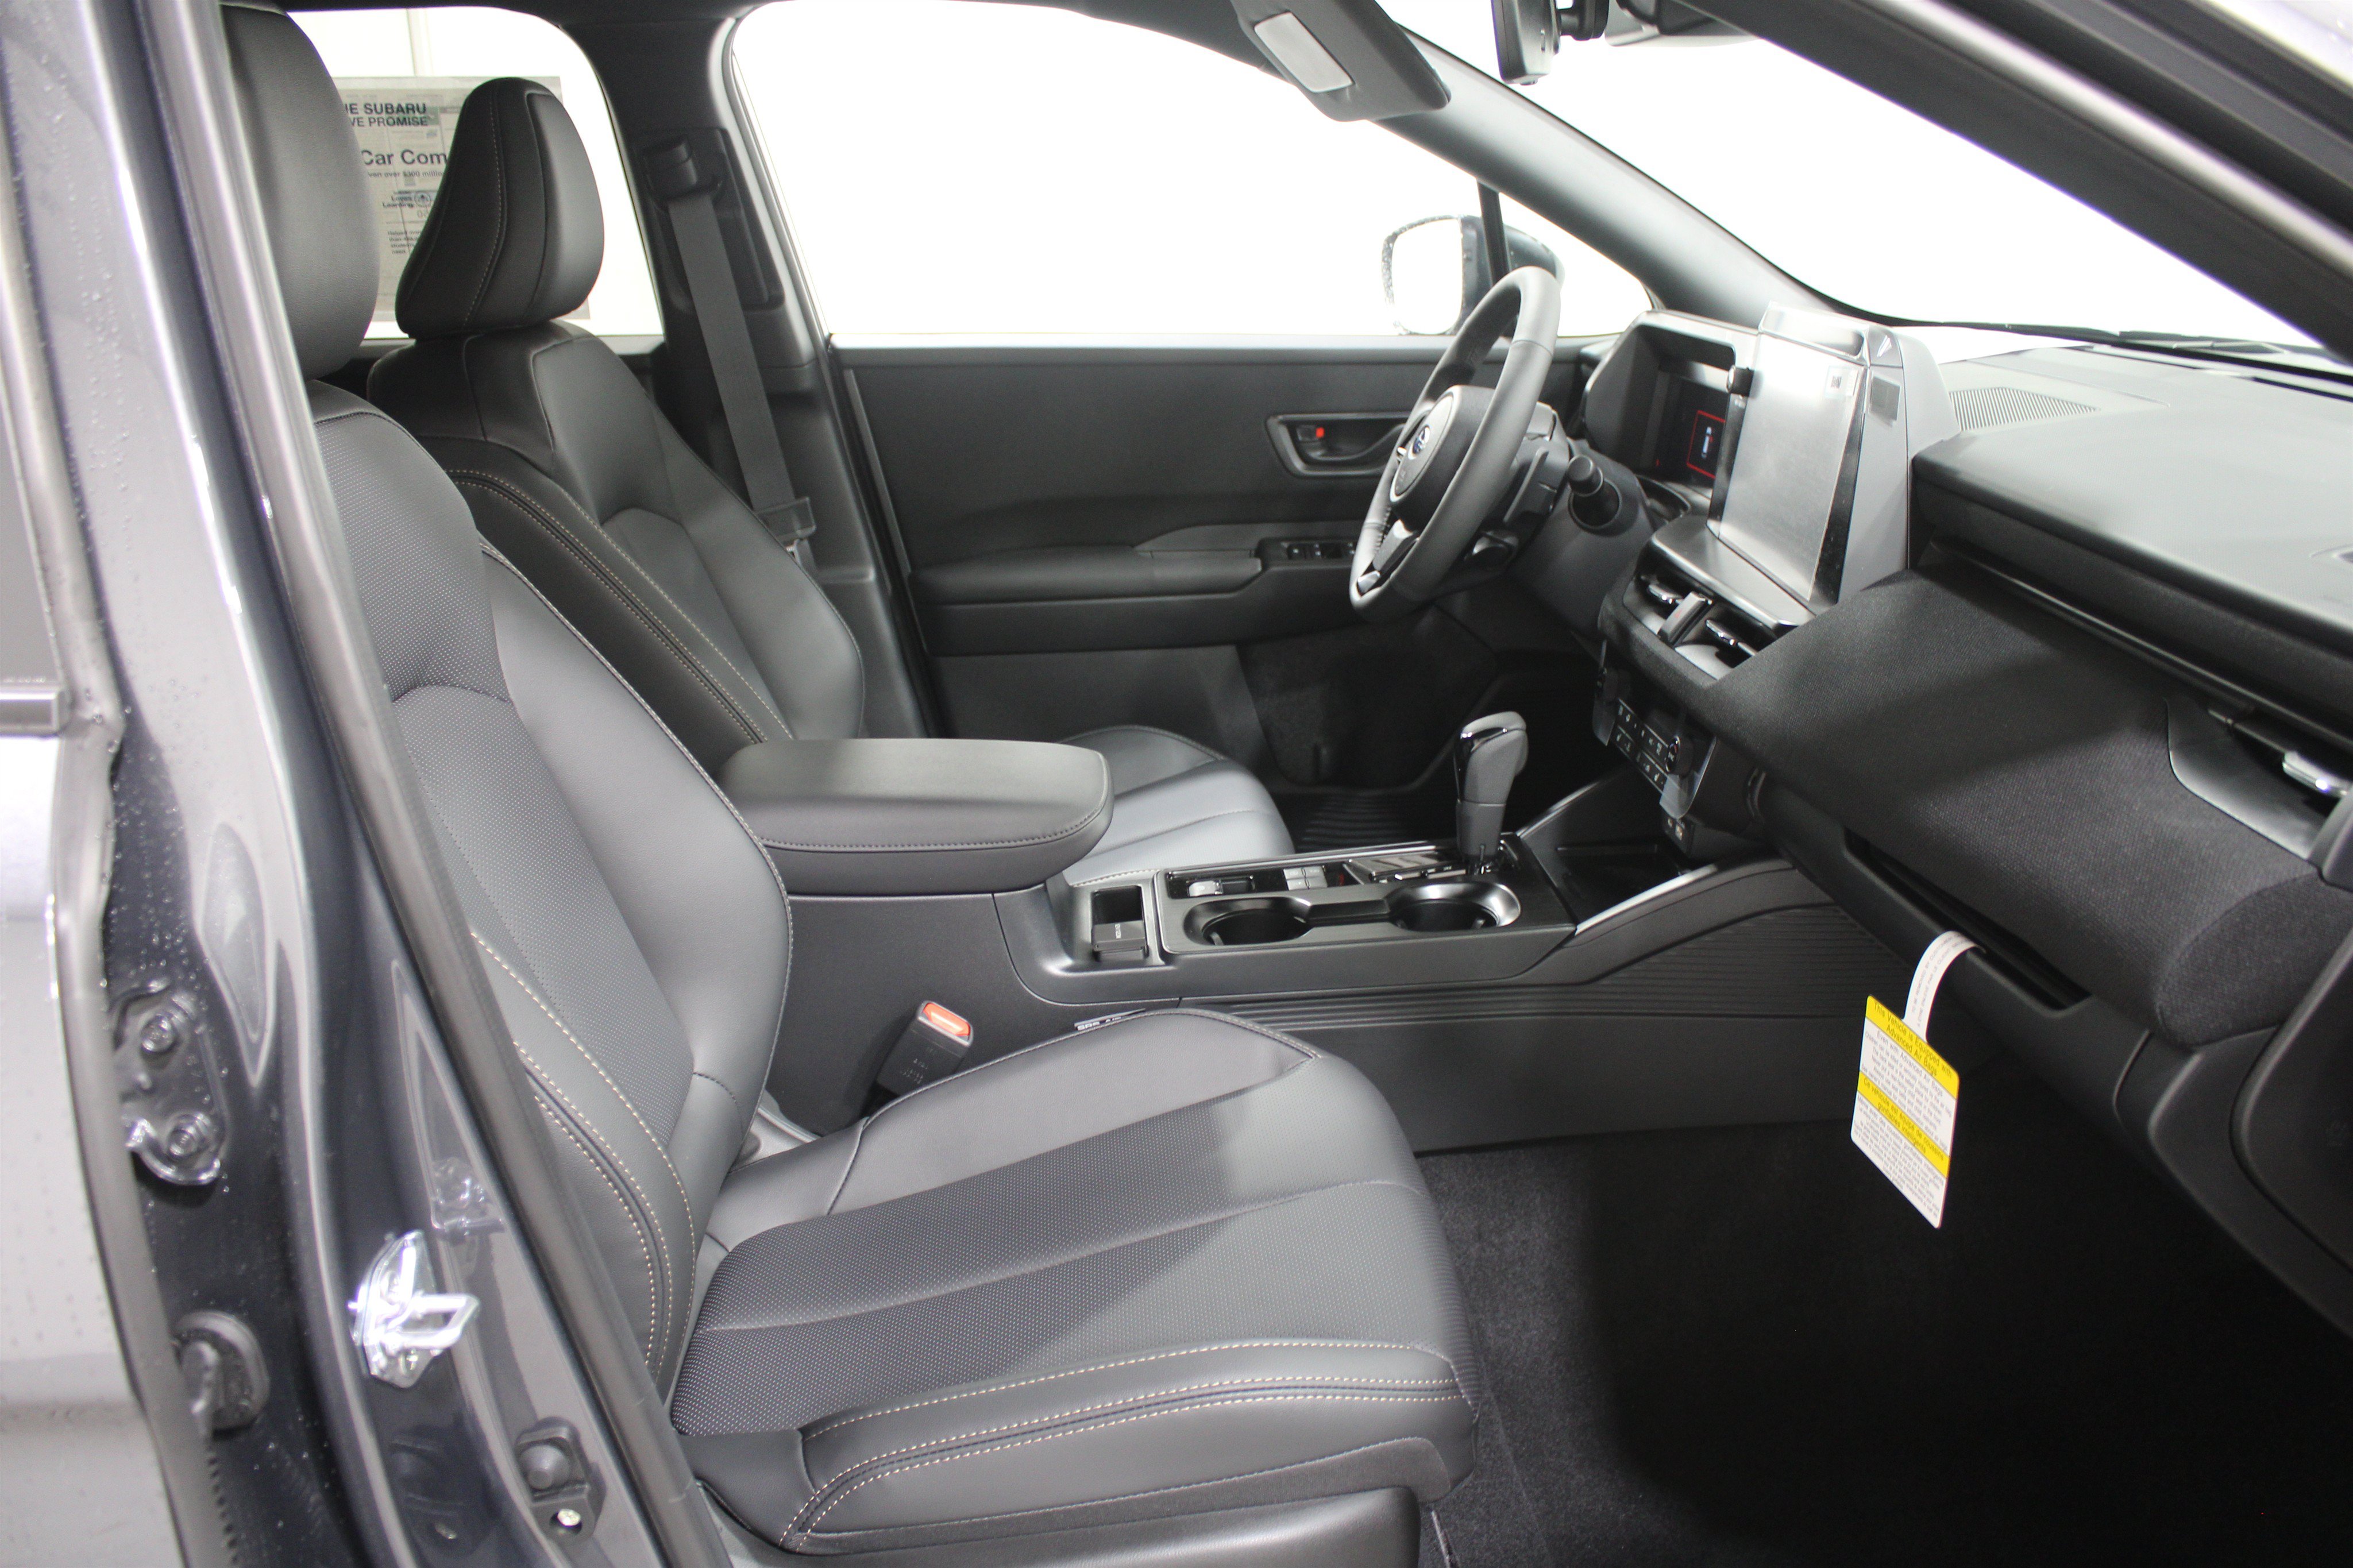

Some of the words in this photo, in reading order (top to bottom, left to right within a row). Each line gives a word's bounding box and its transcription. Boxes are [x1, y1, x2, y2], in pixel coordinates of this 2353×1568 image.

[364, 103, 426, 114] SUBARU
[368, 117, 429, 126] PROMISE
[361, 150, 394, 165] Car
[1874, 1003, 1884, 1017] This
[1887, 1014, 1906, 1036] Vehicle
[1908, 1032, 1913, 1042] is
[1915, 1040, 1939, 1066] Equipped
[1941, 1064, 1951, 1078] with
[1877, 1032, 1888, 1045] Even
[1889, 1042, 1899, 1055] with
[1900, 1052, 1922, 1076] Advanced
[1931, 1082, 1942, 1096] Bags
[1887, 1025, 1912, 1052] Advanced
[1914, 1049, 1922, 1061] Air
[1923, 1059, 1937, 1077] Bags
[1864, 1077, 1870, 1088] Ce
[1872, 1086, 1889, 1107] véhicule
[1899, 1113, 1914, 1133] équipé
[1916, 1128, 1922, 1139] de
[1923, 1138, 1943, 1160] coussins
[1878, 1102, 1900, 1129] gonflables
[1901, 1126, 1926, 1154] intelligents
